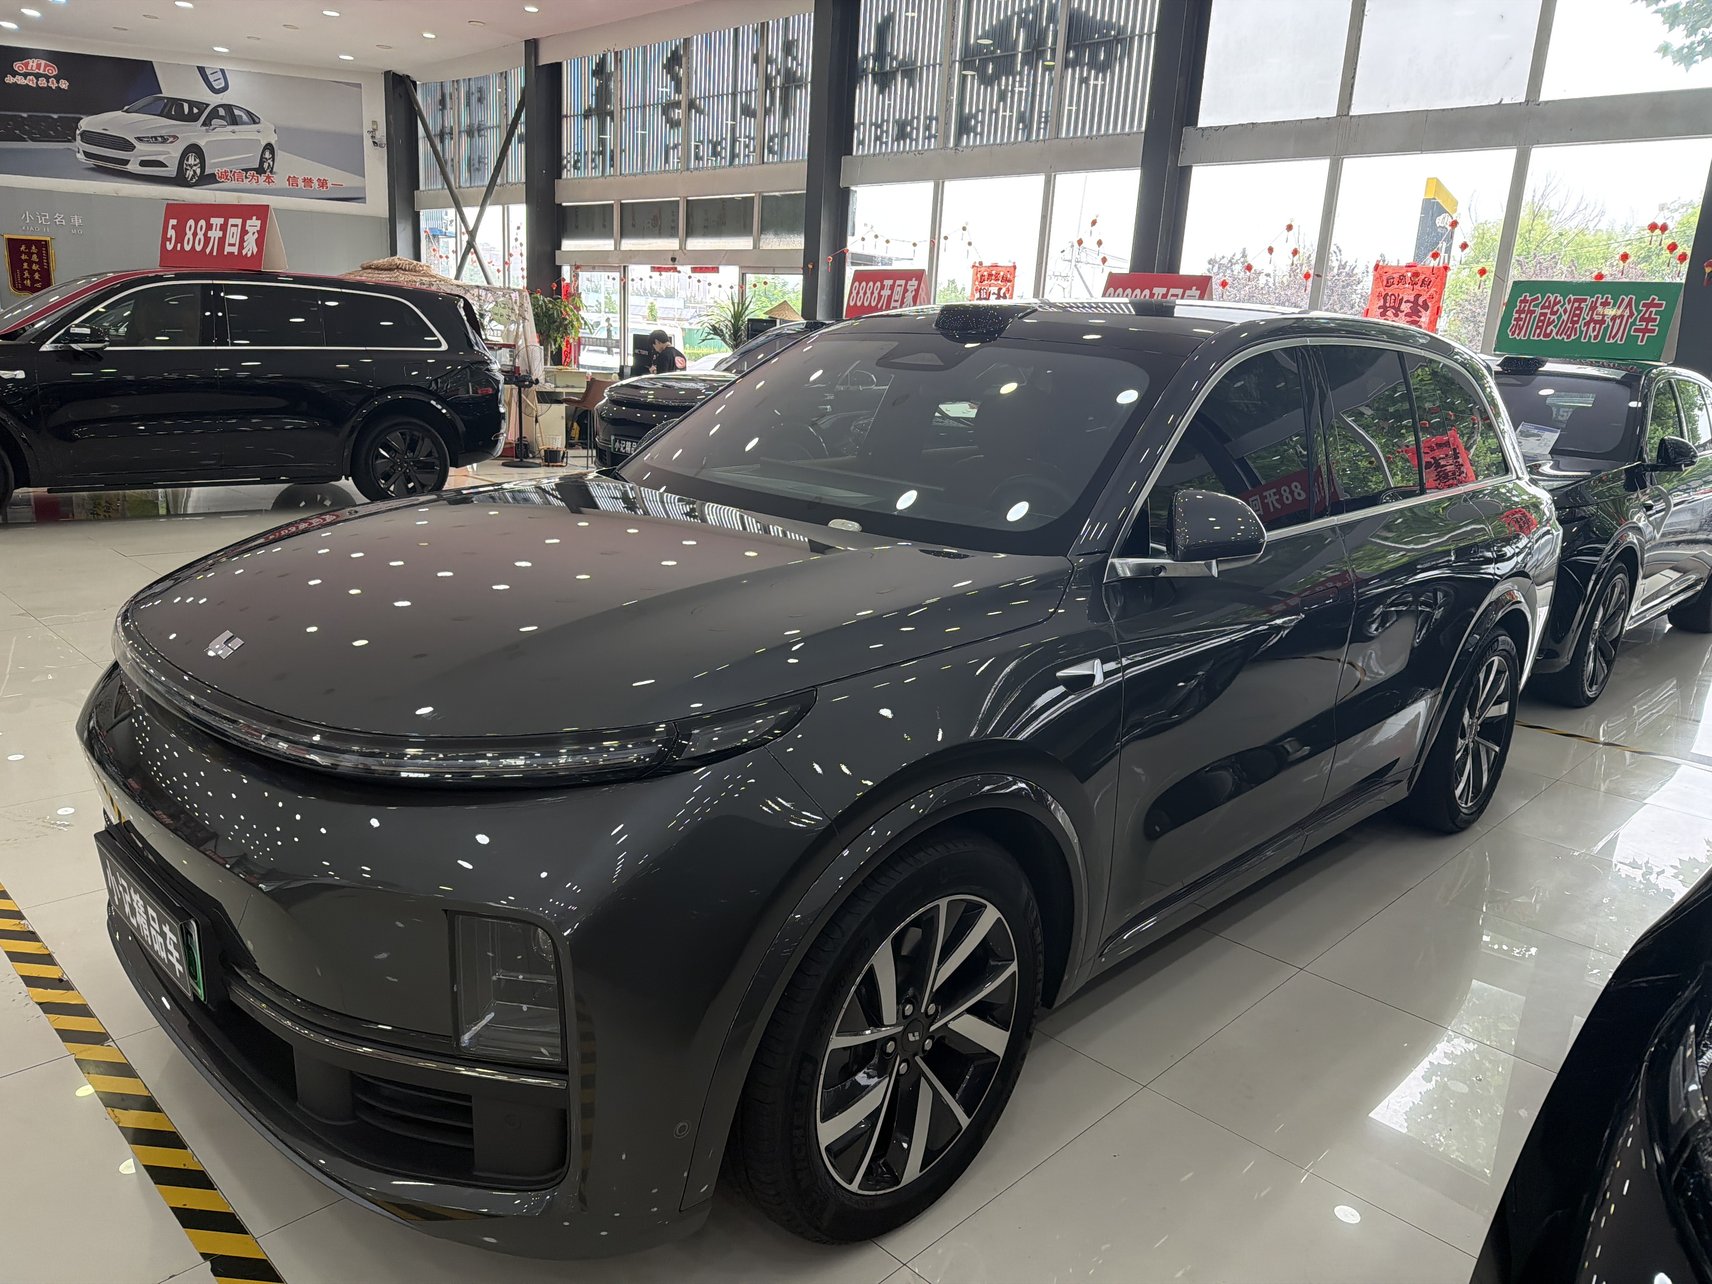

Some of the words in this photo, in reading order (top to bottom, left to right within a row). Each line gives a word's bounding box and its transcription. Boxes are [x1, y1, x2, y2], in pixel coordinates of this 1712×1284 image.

[4, 74, 70, 90] 小记精品车行
[215, 168, 276, 186] 诚信为本
[286, 174, 345, 190] 信誉第一
[21, 211, 84, 227] 小记名車
[165, 216, 262, 257] 5.88开回家
[850, 278, 918, 310] 8888开回家
[1508, 293, 1666, 346] 新能源特价车
[106, 859, 184, 978] 小记精品车
